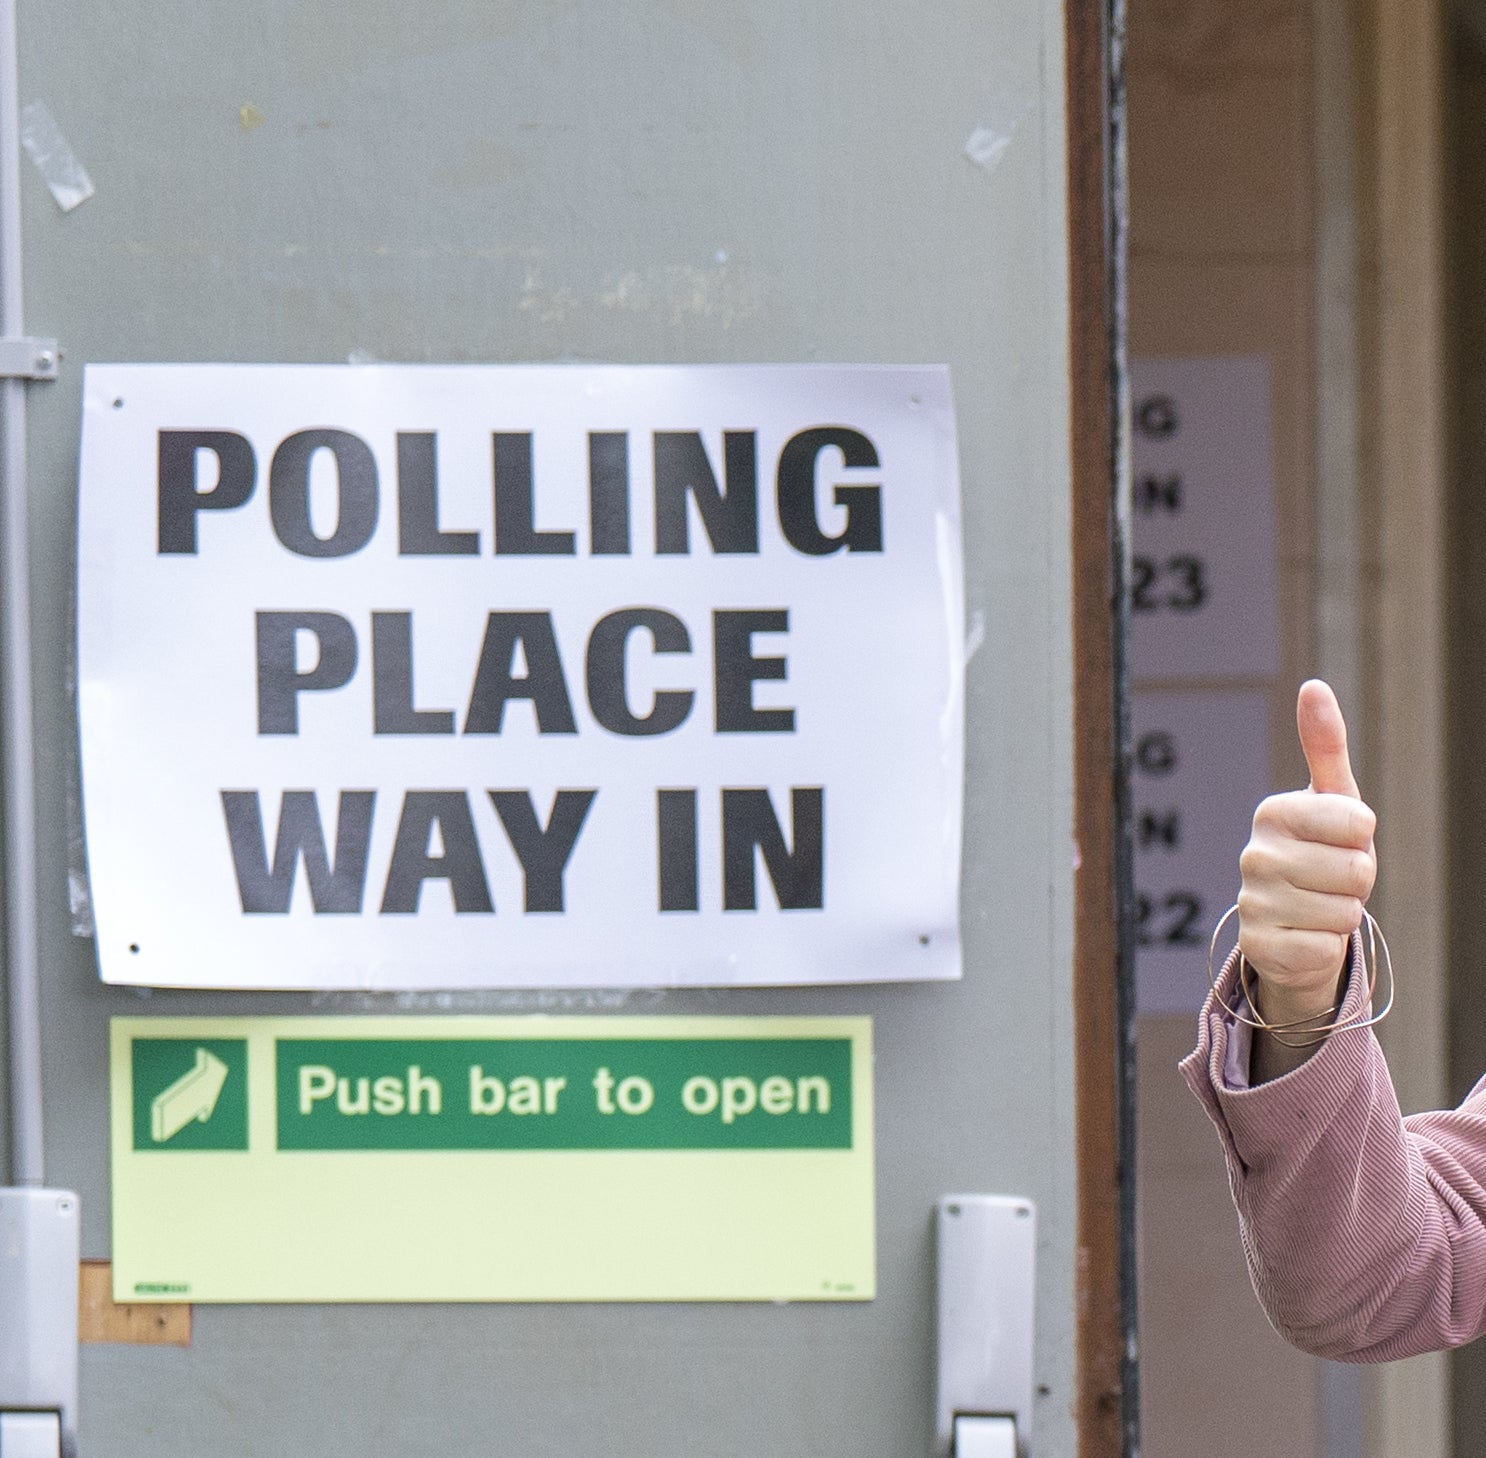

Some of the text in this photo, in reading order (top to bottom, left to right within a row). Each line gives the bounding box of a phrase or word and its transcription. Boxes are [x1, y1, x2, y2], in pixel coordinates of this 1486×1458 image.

[158, 425, 884, 558] POLLING
[256, 607, 796, 737] PLACE
[220, 786, 825, 915] WAY IN
[299, 1065, 831, 1124] Push bar to open
